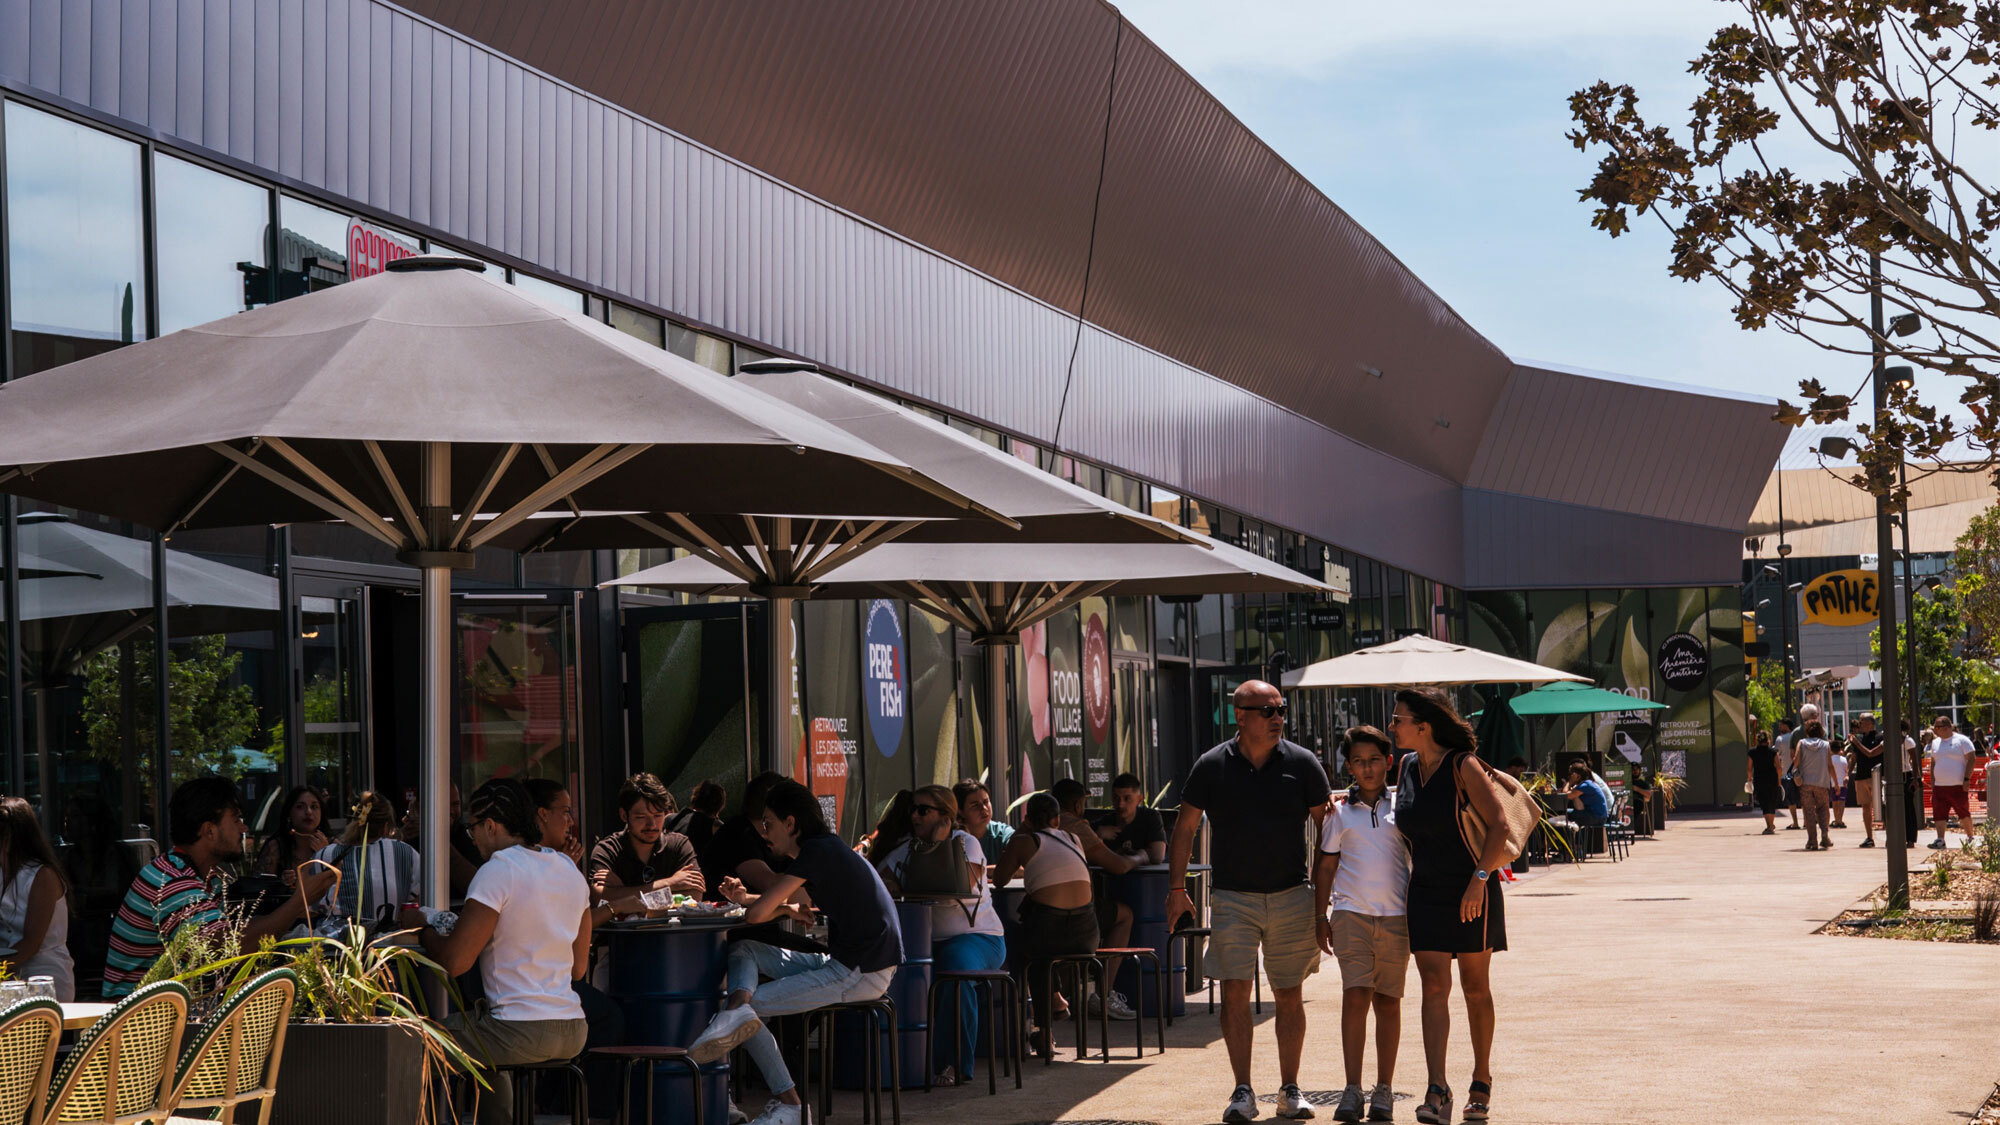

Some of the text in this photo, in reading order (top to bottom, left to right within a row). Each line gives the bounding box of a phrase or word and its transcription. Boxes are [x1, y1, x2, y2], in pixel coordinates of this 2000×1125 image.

[869, 643, 893, 679] PERE
[1053, 670, 1081, 705] FOOD
[1600, 686, 1651, 701] OD
[880, 681, 903, 718] FISH
[814, 717, 848, 733] RETROUVEZ
[1053, 708, 1082, 733] VILLAGE
[1660, 720, 1700, 729] RETROUVEZ
[1660, 730, 1673, 738] LES
[815, 740, 826, 755] LES
[816, 762, 845, 778] INFOS SUR
